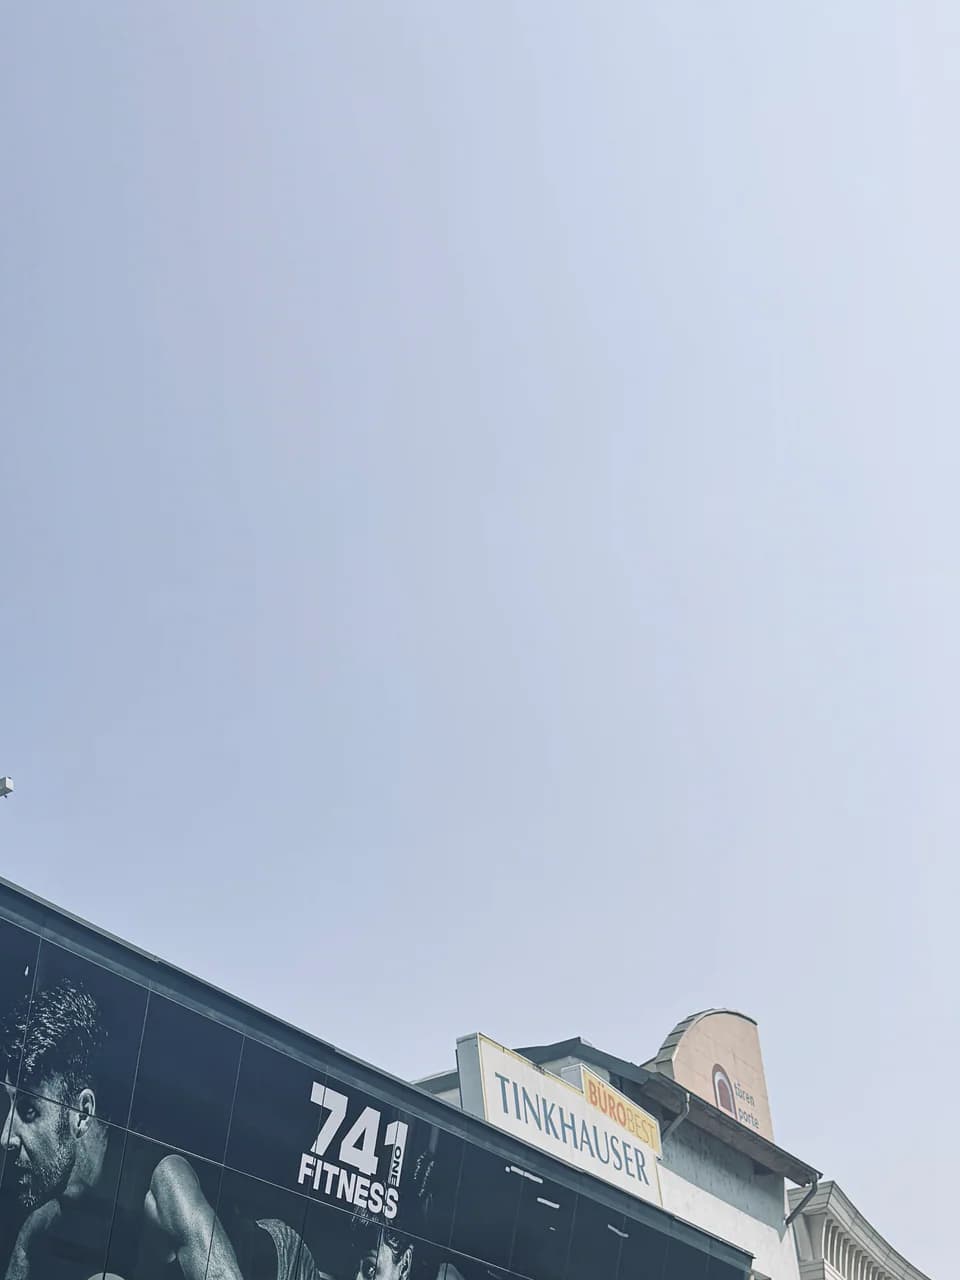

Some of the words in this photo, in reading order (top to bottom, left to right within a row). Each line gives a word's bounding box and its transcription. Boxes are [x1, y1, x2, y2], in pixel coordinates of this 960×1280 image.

[310, 1081, 408, 1187] 741
[495, 1072, 649, 1185] TINKHAUSER
[587, 1079, 657, 1146] BÜROBEST
[297, 1152, 399, 1219] FITNESS
[390, 1145, 403, 1186] ONE
